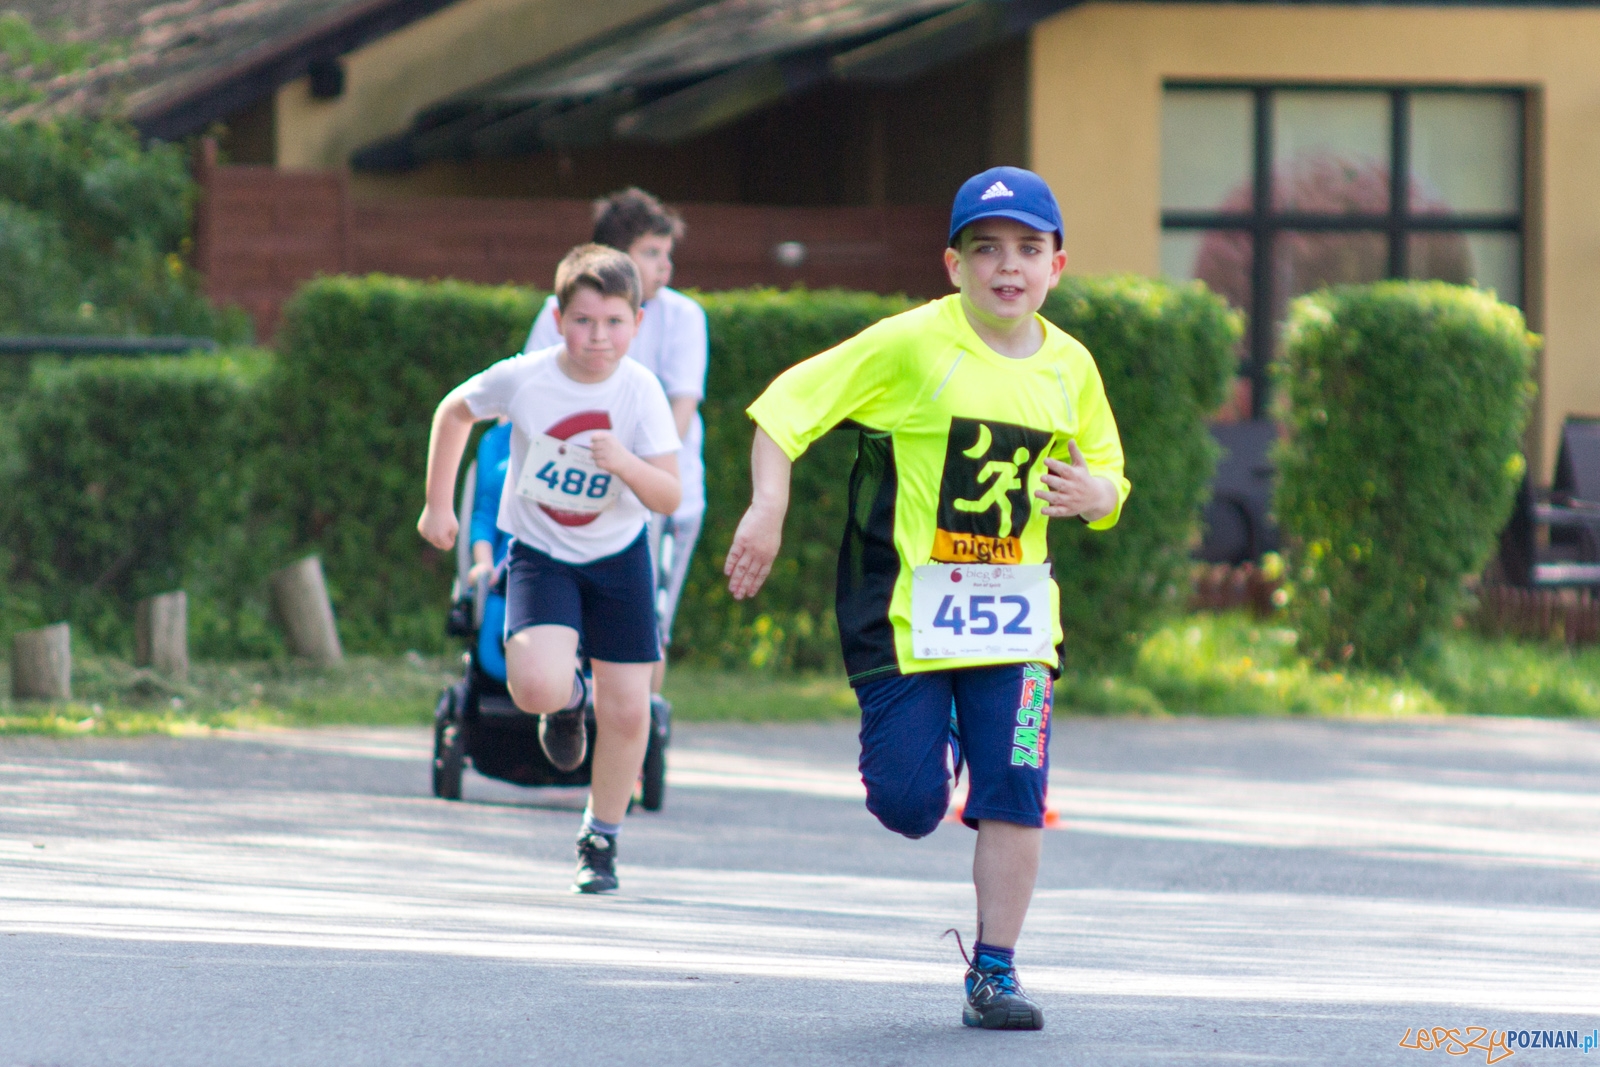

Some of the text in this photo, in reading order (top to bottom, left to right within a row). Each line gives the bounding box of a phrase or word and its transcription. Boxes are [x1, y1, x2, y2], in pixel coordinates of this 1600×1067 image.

[535, 461, 612, 498] 488
[953, 534, 1015, 562] night
[932, 594, 1033, 636] 452
